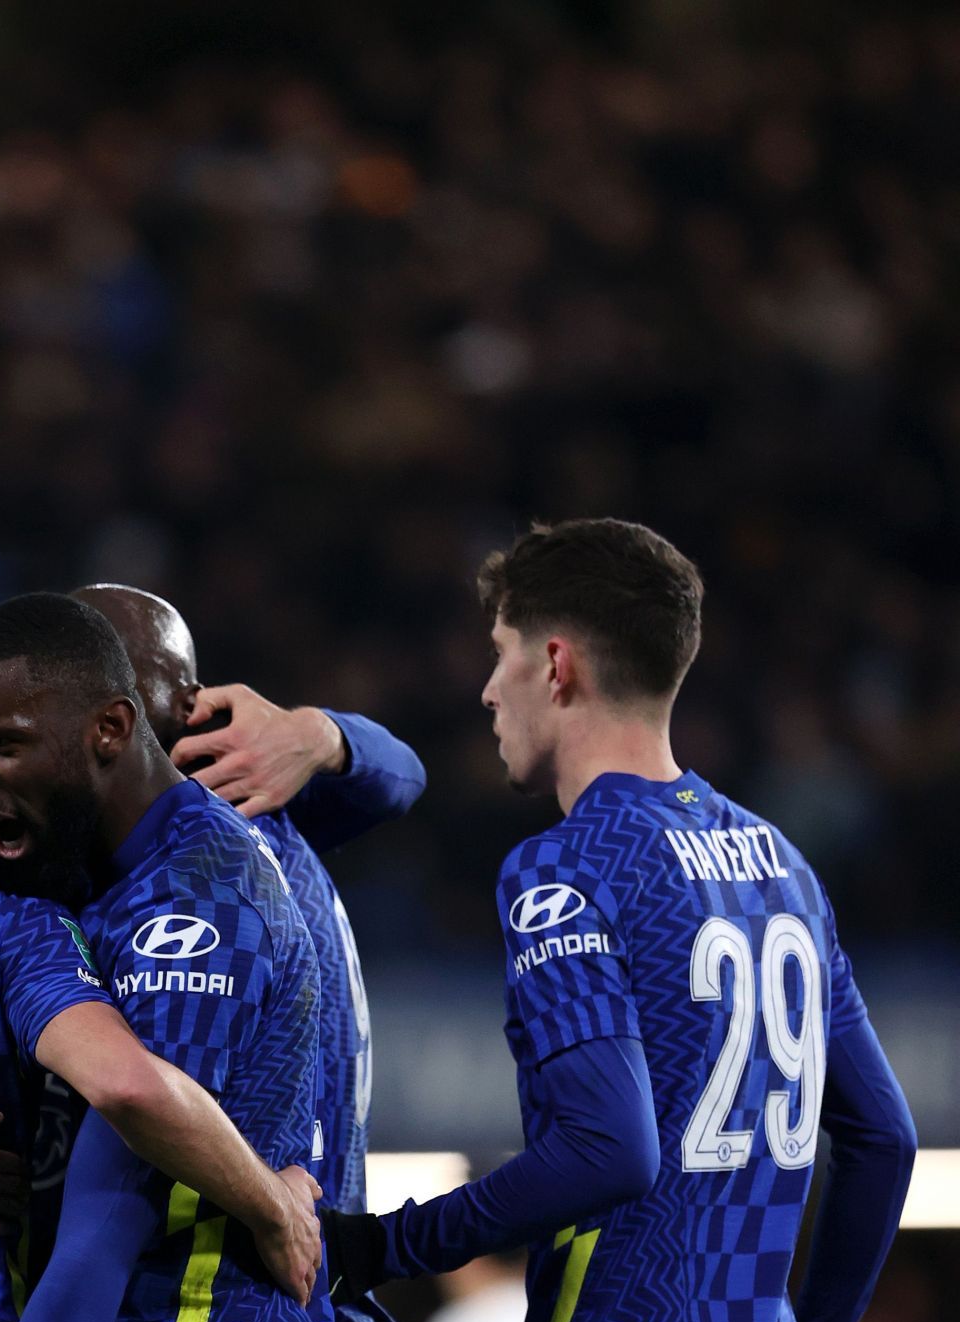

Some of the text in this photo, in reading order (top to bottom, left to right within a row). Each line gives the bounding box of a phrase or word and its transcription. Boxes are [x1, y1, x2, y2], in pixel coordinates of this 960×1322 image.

[665, 825, 789, 882] HAVERTZ
[513, 932, 611, 979] HYUNDAI
[114, 970, 235, 998] HYUNDAI
[680, 912, 827, 1173] 29
